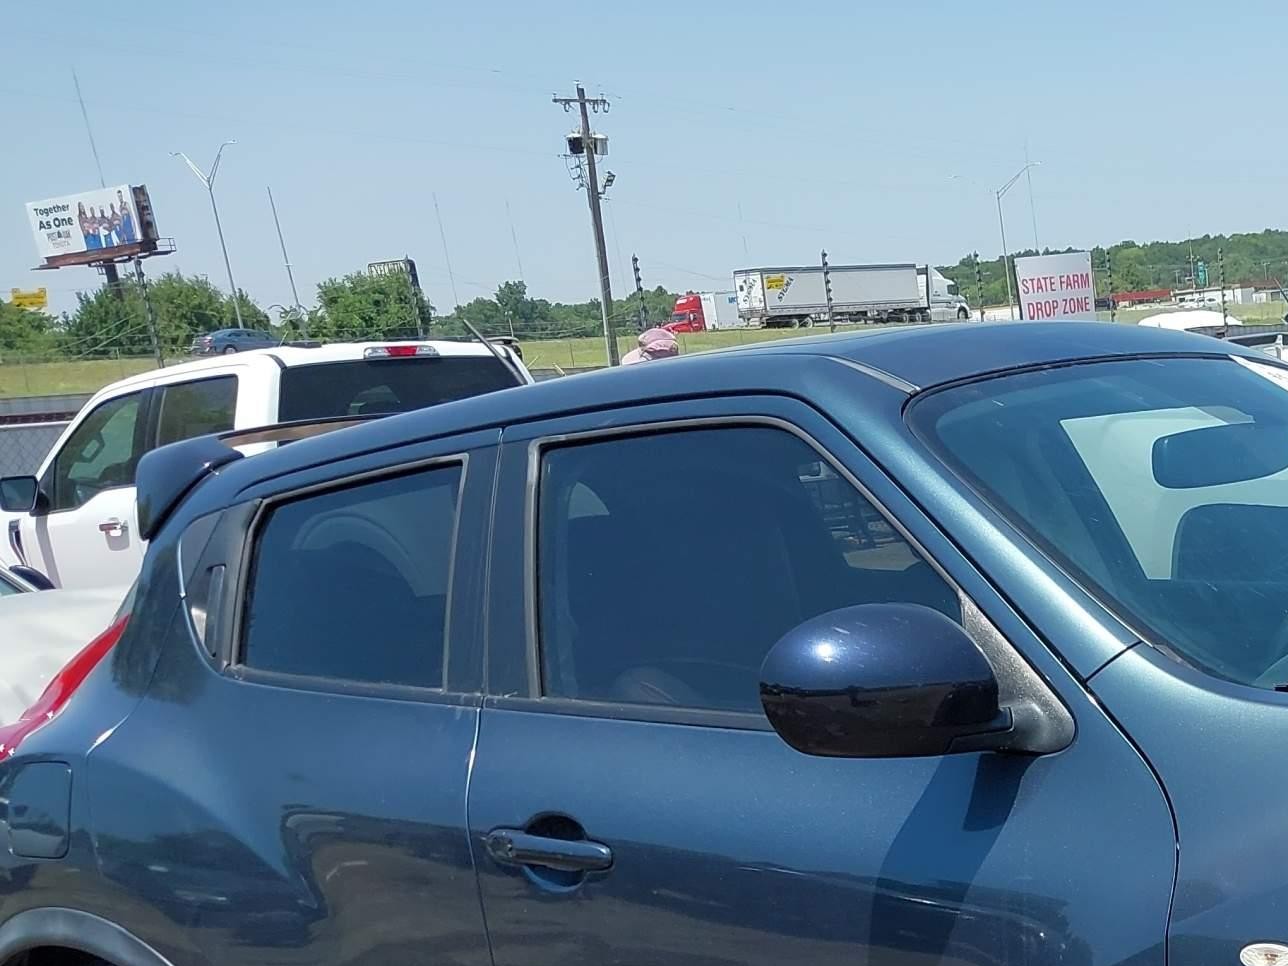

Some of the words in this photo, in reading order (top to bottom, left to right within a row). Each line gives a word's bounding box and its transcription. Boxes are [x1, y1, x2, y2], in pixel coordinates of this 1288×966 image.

[33, 203, 70, 217] Together
[39, 220, 52, 231] As
[53, 217, 74, 228] One
[1021, 276, 1056, 295] STATE
[1059, 272, 1090, 291] FARM
[1027, 299, 1059, 320] DROP
[1062, 297, 1090, 314] ZONE
